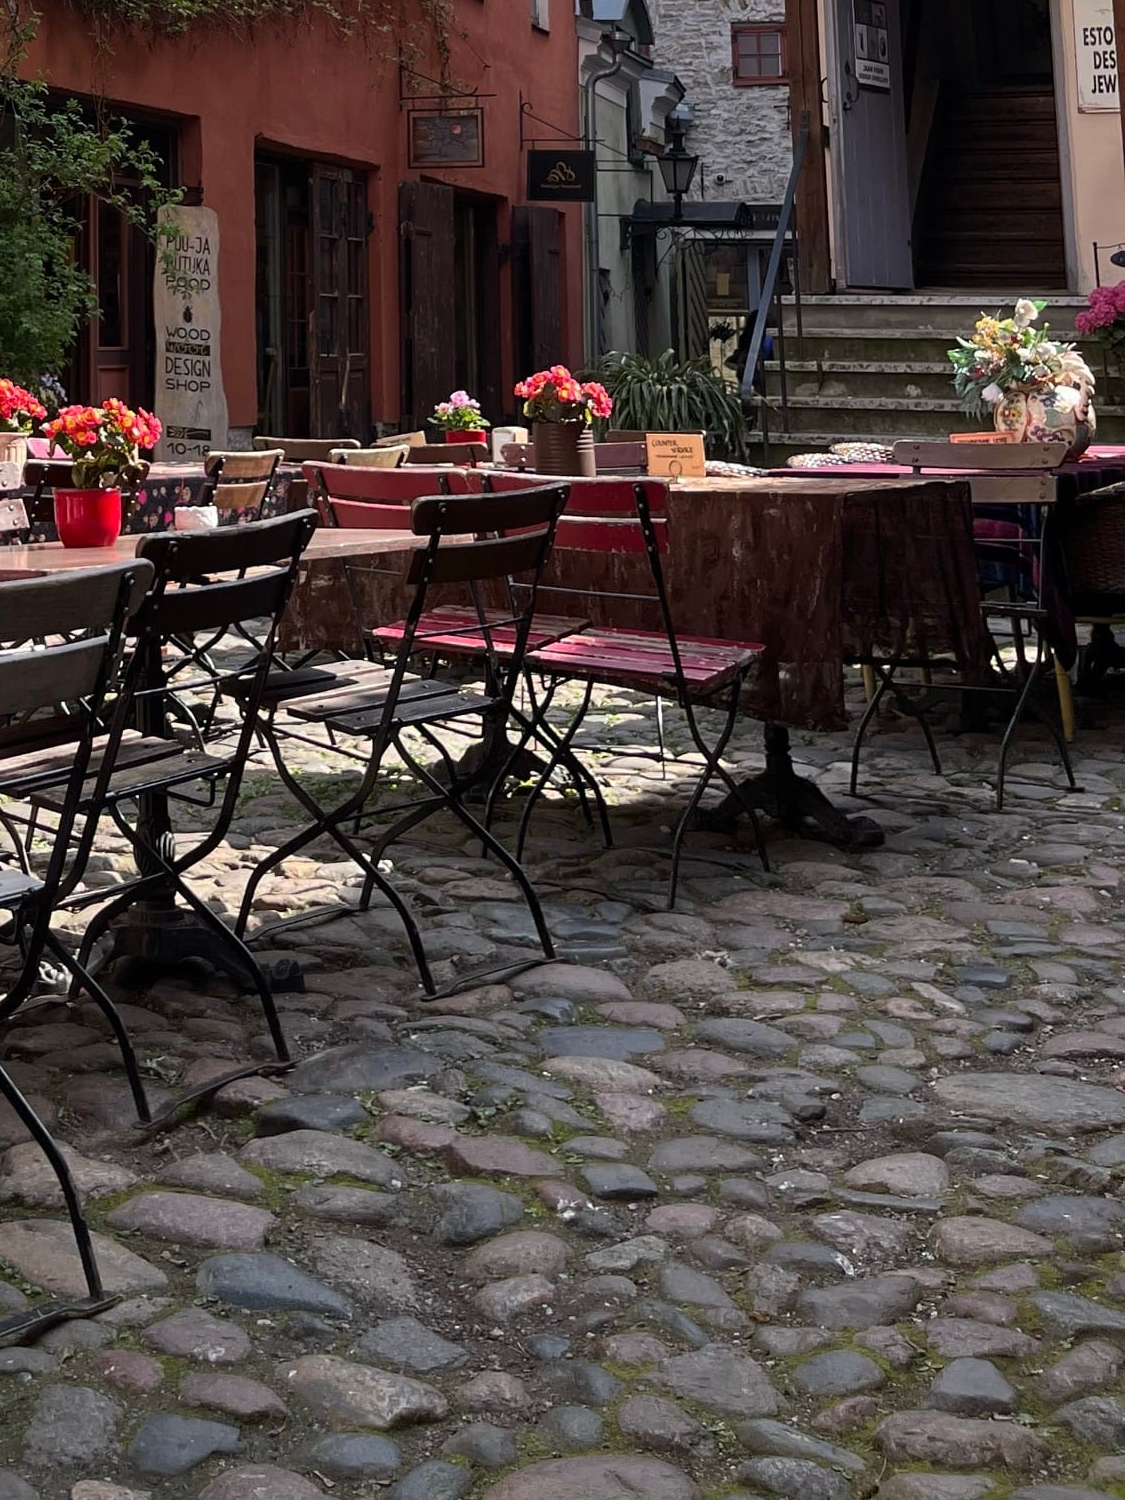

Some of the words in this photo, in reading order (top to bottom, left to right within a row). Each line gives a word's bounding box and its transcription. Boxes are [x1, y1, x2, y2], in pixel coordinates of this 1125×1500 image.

[1083, 26, 1114, 46] ESTO
[166, 255, 211, 276] UTUKA
[165, 325, 211, 341] WOOD
[165, 356, 211, 377] DESIGN
[165, 378, 211, 392] SHOP
[166, 442, 211, 457] 10-18
